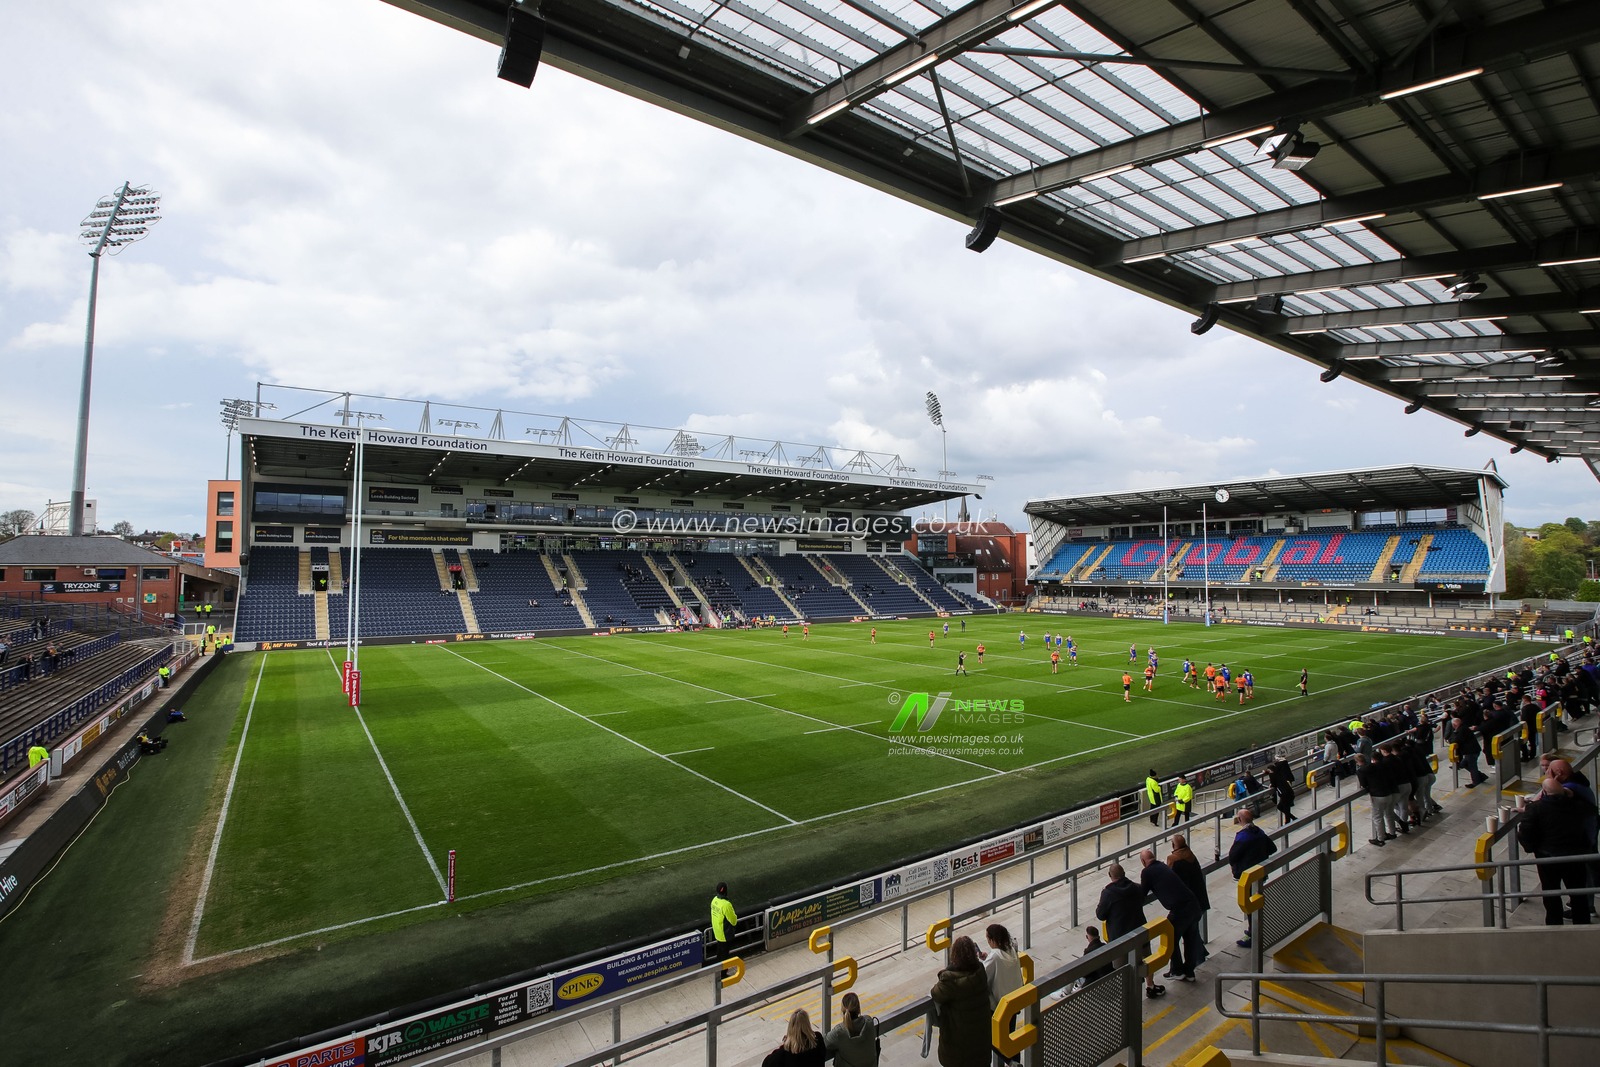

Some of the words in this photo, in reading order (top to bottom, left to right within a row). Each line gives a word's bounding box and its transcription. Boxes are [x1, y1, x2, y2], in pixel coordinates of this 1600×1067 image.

[300, 425, 326, 438] The
[368, 432, 418, 445] Howard
[422, 436, 488, 451] Foundation
[559, 448, 577, 458] The
[580, 450, 604, 460] Keith
[607, 453, 643, 464] Howard
[646, 457, 695, 468] Foundation
[747, 465, 762, 474] The
[762, 466, 782, 476] Keith
[783, 469, 811, 478] Howard
[812, 471, 850, 482] Foundation
[889, 478, 901, 486] The
[901, 479, 915, 487] Keith
[916, 480, 938, 489] Howard
[938, 483, 968, 492] Foundation
[953, 852, 978, 870] Best
[953, 864, 978, 876] BRICKWORK
[886, 887, 900, 896] DJM
[771, 902, 822, 930] Chapman
[607, 957, 635, 970] BUILDING
[642, 944, 672, 959] PLUMBING
[673, 937, 700, 949] SUPPLIES
[618, 964, 646, 976] MEANWOOD
[626, 961, 683, 983] www.aespink.com
[562, 976, 600, 996] SPINKS
[499, 1005, 518, 1013] Waste
[501, 999, 516, 1007] Your
[428, 1003, 490, 1033] WASTE
[494, 1008, 521, 1020] Removal
[498, 1016, 518, 1025] Needs
[368, 1032, 402, 1053] KJR
[297, 1042, 356, 1067] PARTS
[374, 1042, 441, 1067] www.kjrwaste.co.uk
